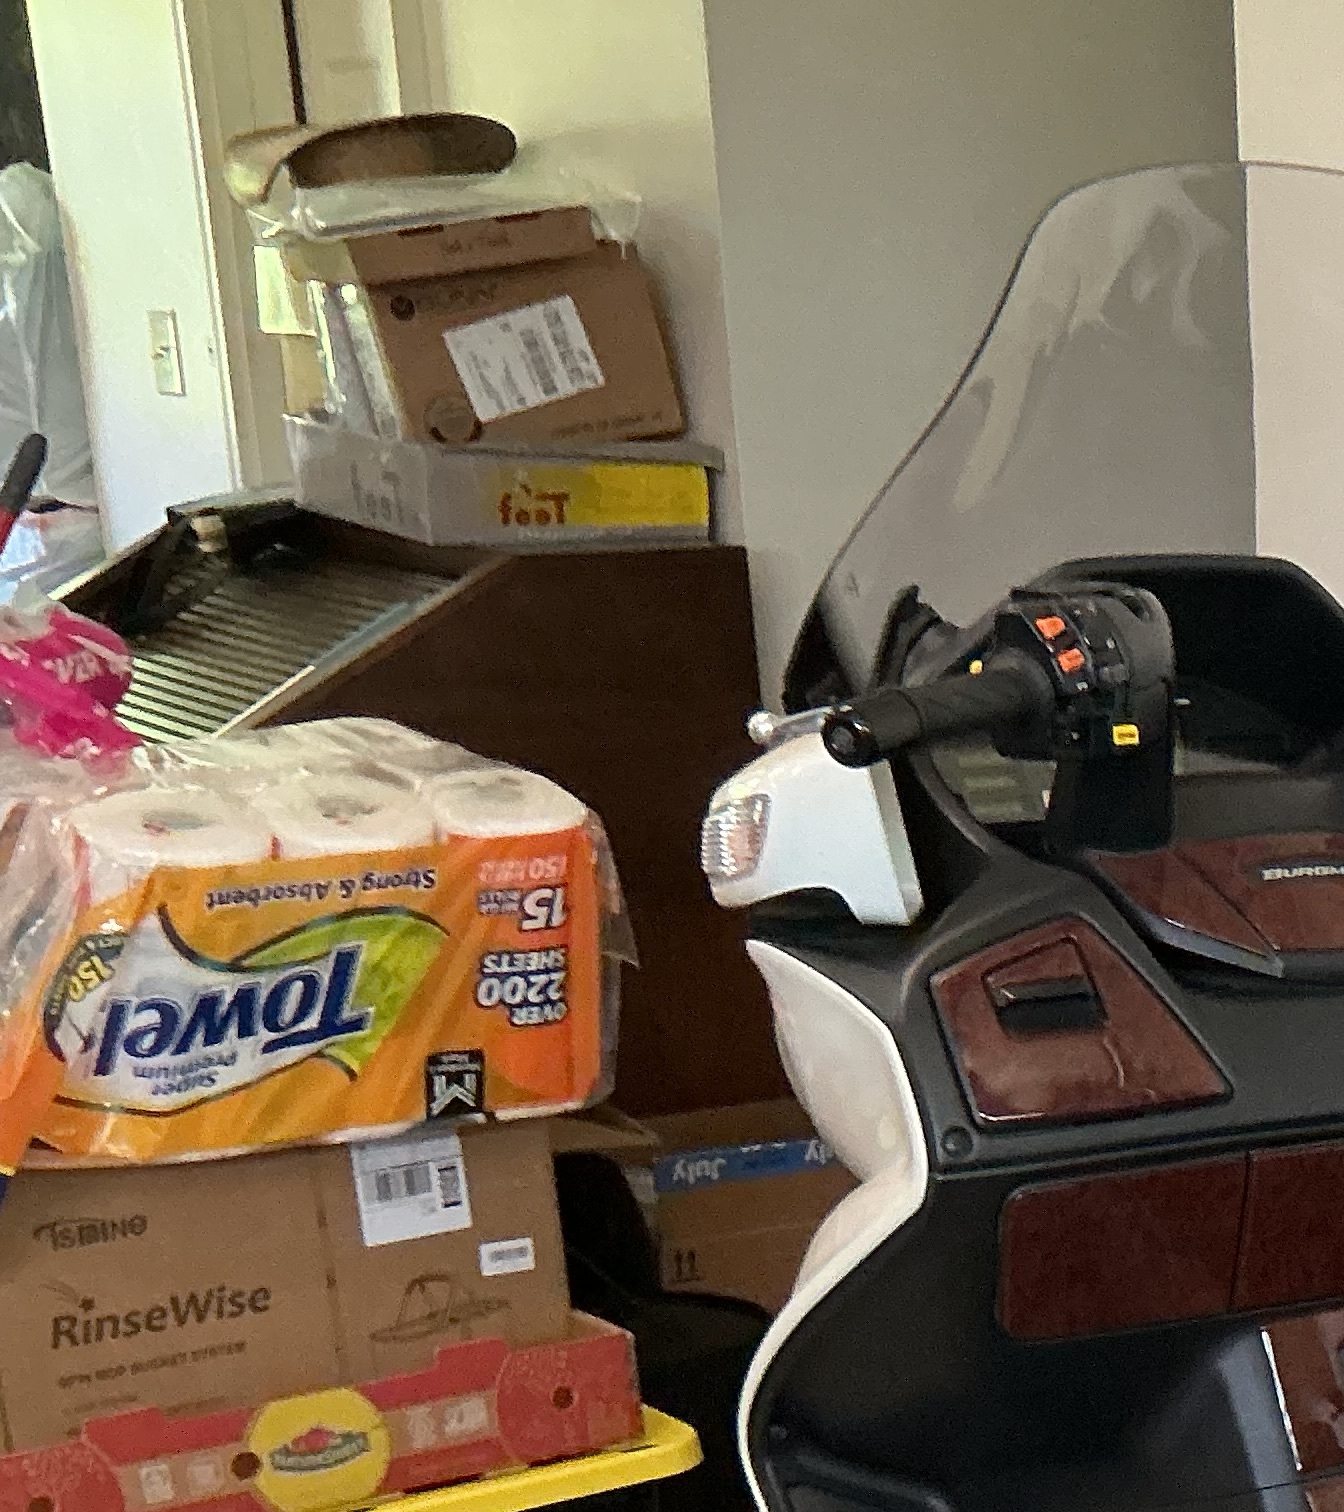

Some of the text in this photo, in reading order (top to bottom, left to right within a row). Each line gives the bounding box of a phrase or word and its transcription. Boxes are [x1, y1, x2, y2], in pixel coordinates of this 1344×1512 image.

[204, 868, 438, 914] Strong & Absorbent
[520, 886, 567, 931] 15
[482, 948, 567, 973] SHEETS
[94, 944, 373, 1077] Towel
[476, 971, 566, 1007] 2200
[51, 1282, 272, 1350] RinseWise
